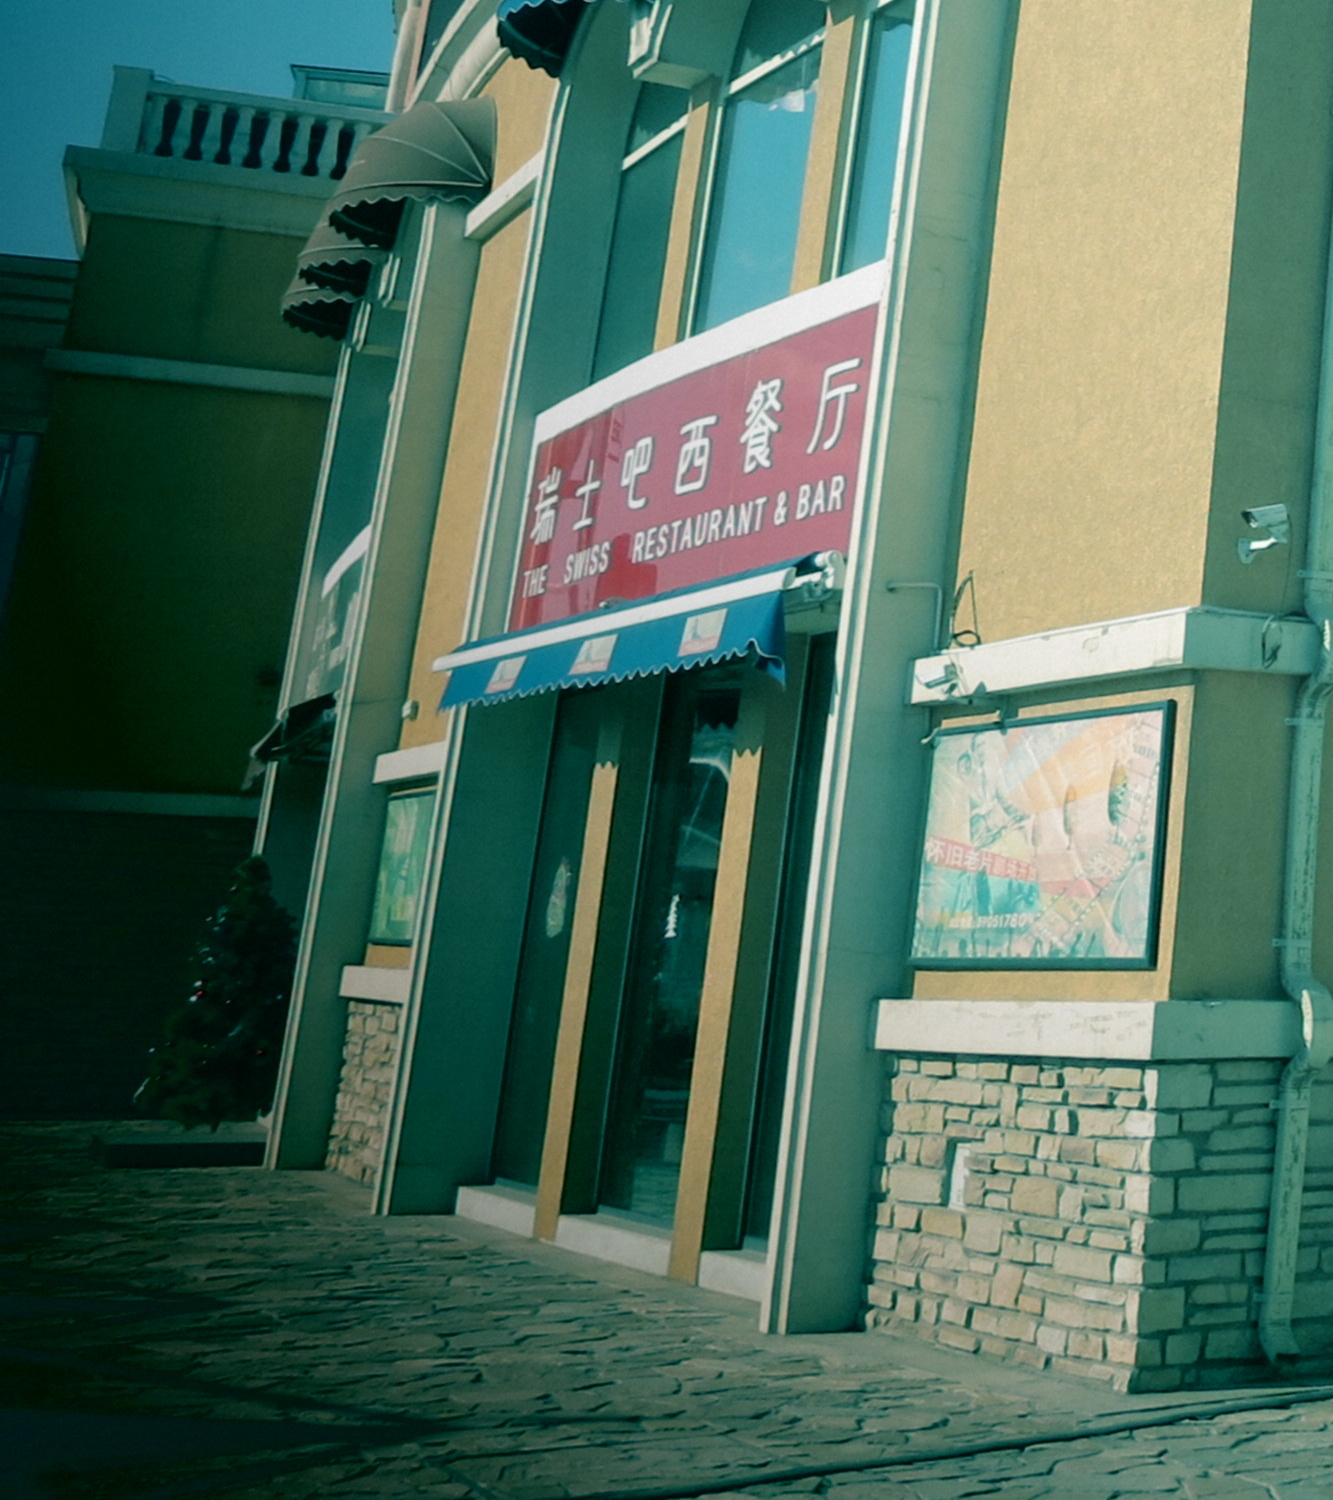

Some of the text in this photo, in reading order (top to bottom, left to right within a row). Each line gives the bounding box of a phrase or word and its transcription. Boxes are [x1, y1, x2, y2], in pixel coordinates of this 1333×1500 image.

[529, 357, 861, 546] 瑞士吧西餐厅
[523, 474, 847, 599] THE SWISS RESTAURANT & BAR
